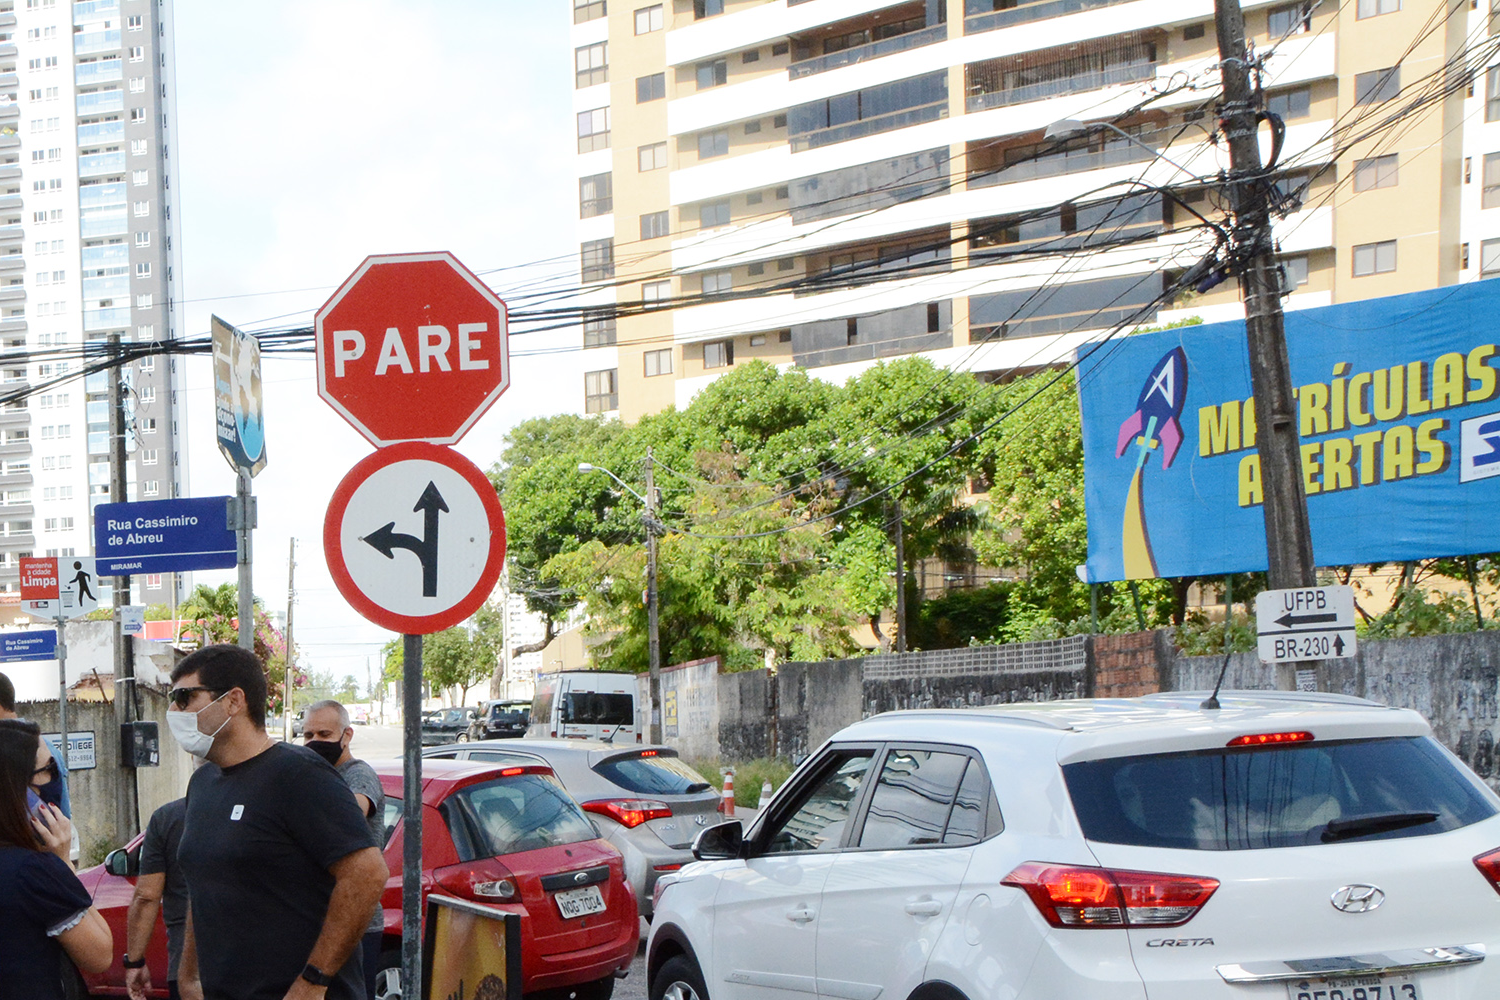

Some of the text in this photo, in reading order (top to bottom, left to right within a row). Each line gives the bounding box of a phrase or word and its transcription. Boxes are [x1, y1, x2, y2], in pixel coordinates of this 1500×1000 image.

[332, 321, 490, 378] PARE
[1198, 344, 1497, 458] MRÍCULAS
[1238, 417, 1446, 507] AERTAS
[107, 515, 198, 531] Rua Cassimiro
[108, 533, 163, 546] de Abreu
[32, 568, 51, 576] cidade
[110, 562, 142, 571] MIRAMAR
[22, 576, 57, 588] Limpa
[1284, 590, 1327, 612] UFPB
[1274, 636, 1330, 659] BR-230
[1146, 937, 1215, 948] CRETA
